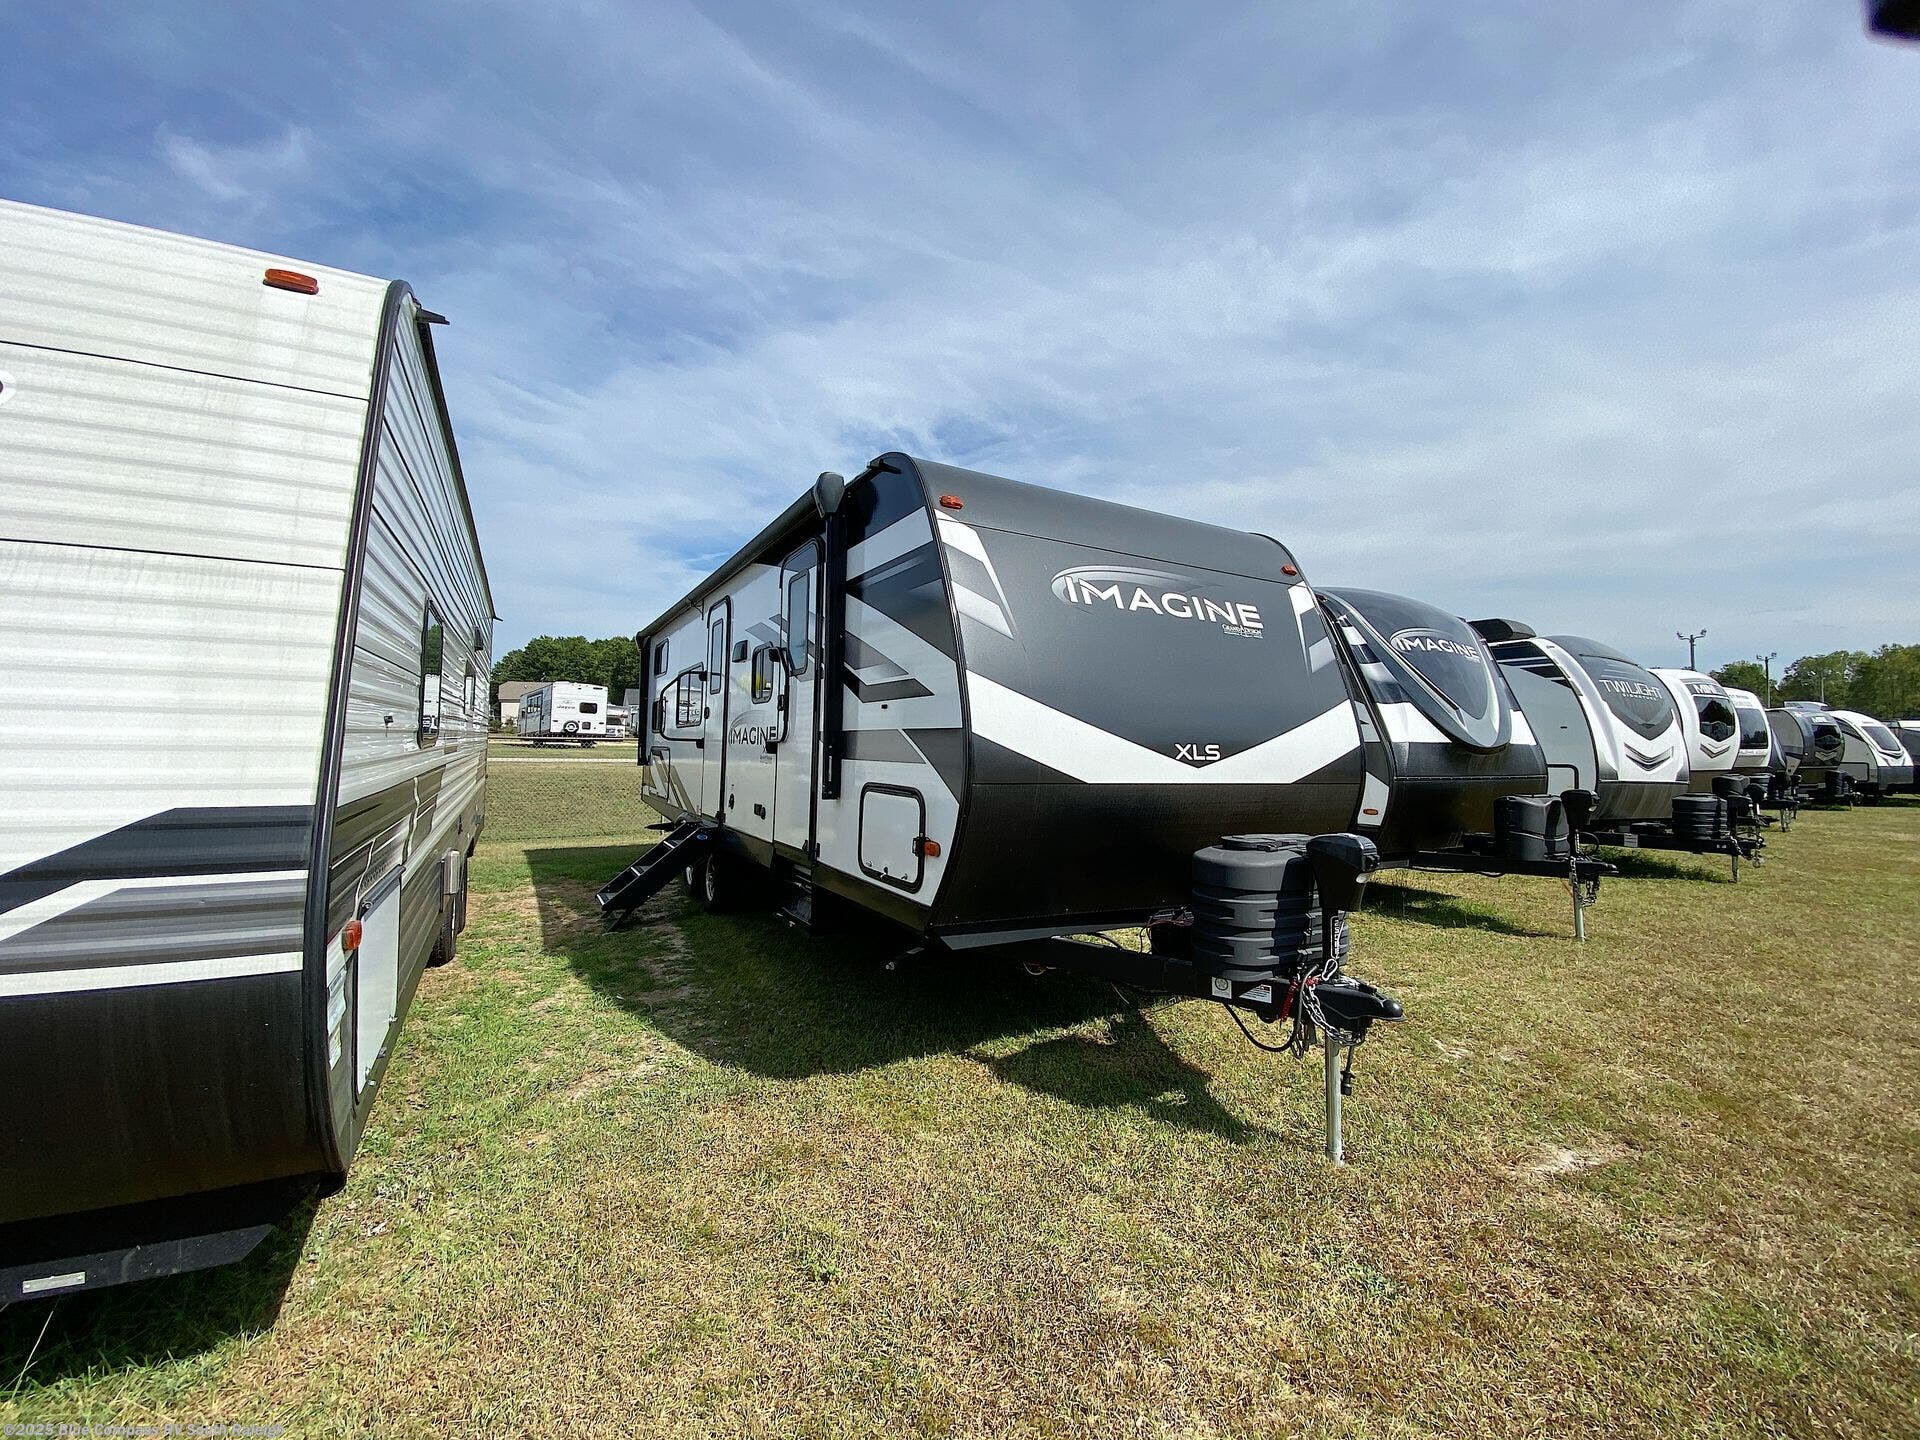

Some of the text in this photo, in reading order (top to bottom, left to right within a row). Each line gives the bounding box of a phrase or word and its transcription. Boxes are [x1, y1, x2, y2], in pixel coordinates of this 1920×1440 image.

[1064, 575, 1264, 629] IMAGINE
[1397, 636, 1479, 658] IMAGINE
[1599, 679, 1663, 699] TWILIGHT
[730, 726, 777, 746] IMAGINE
[1174, 743, 1221, 761] XLS
